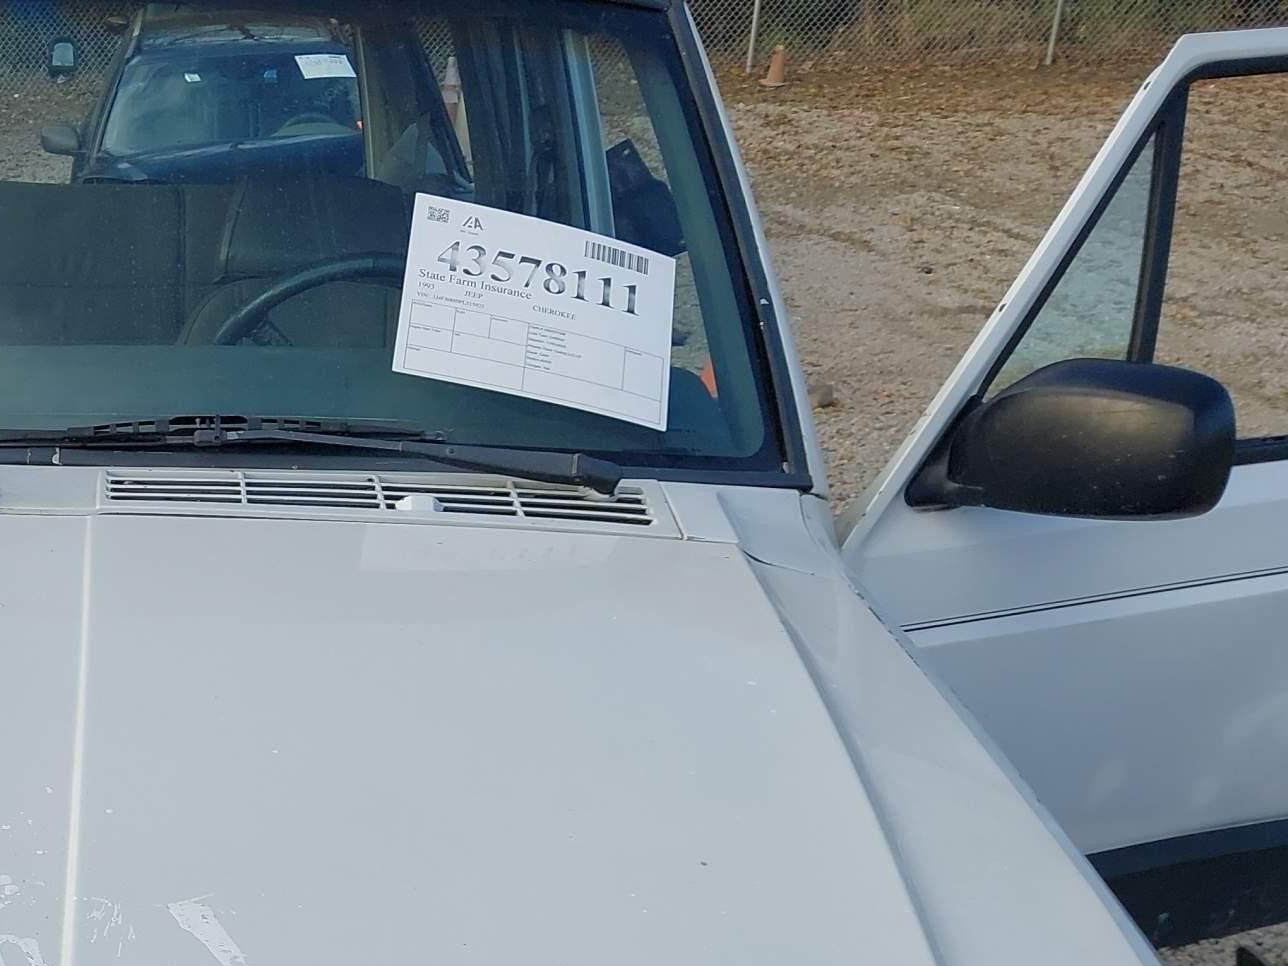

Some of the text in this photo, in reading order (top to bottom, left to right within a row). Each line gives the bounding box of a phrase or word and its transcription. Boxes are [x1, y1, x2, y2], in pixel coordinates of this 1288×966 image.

[418, 268, 533, 300] State Farm Insurance
[437, 240, 641, 317] 43578111
[532, 304, 576, 321] CHEROKEE
